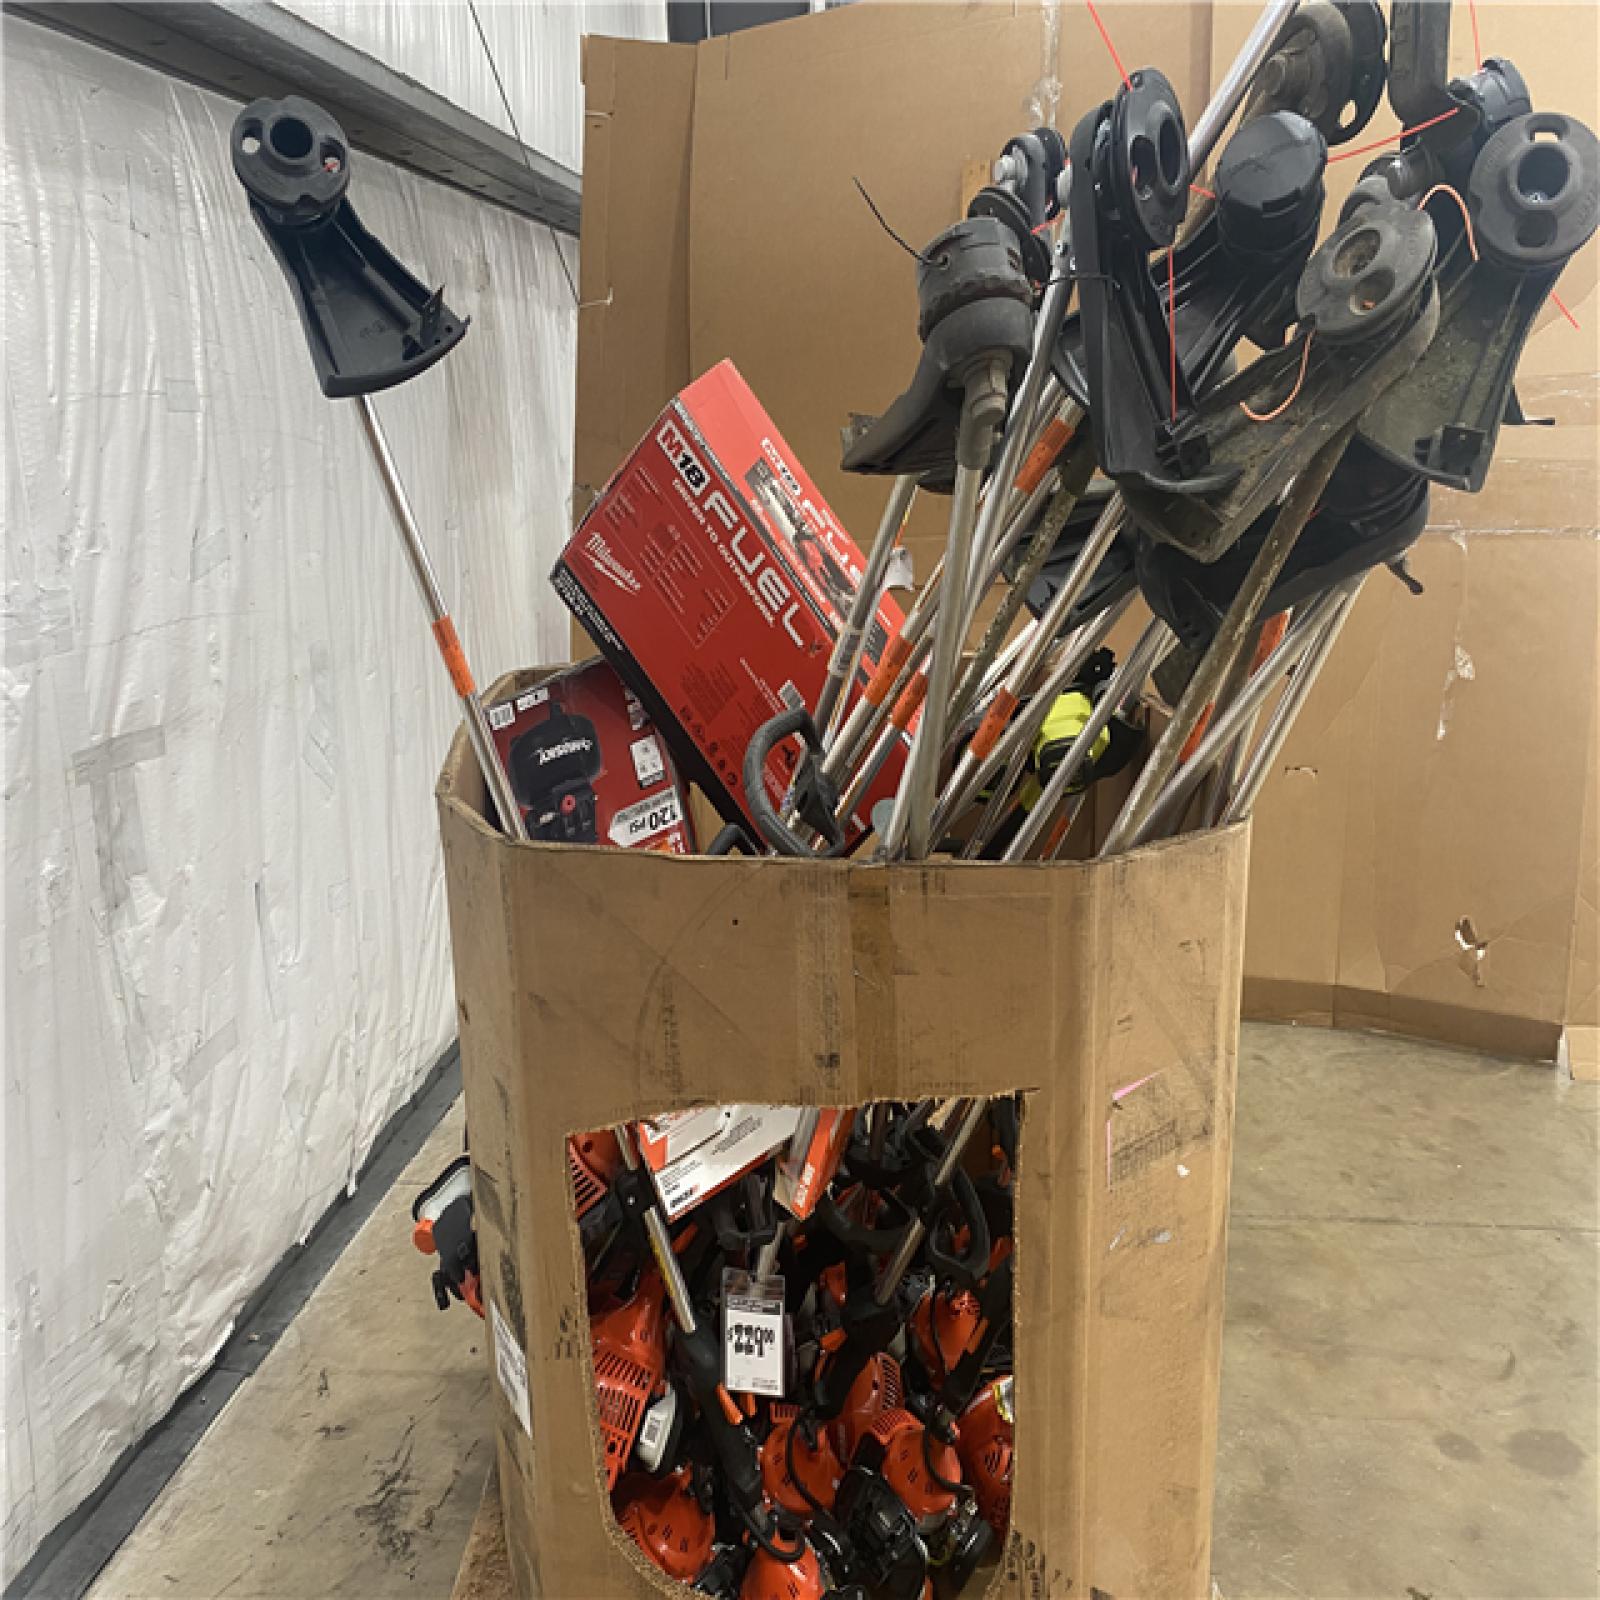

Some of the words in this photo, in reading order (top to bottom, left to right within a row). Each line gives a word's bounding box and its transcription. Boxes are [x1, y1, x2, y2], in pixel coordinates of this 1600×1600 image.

[661, 427, 707, 489] M18
[703, 489, 805, 649] FUEL
[704, 523, 719, 545] TO
[650, 804, 677, 830] 120
